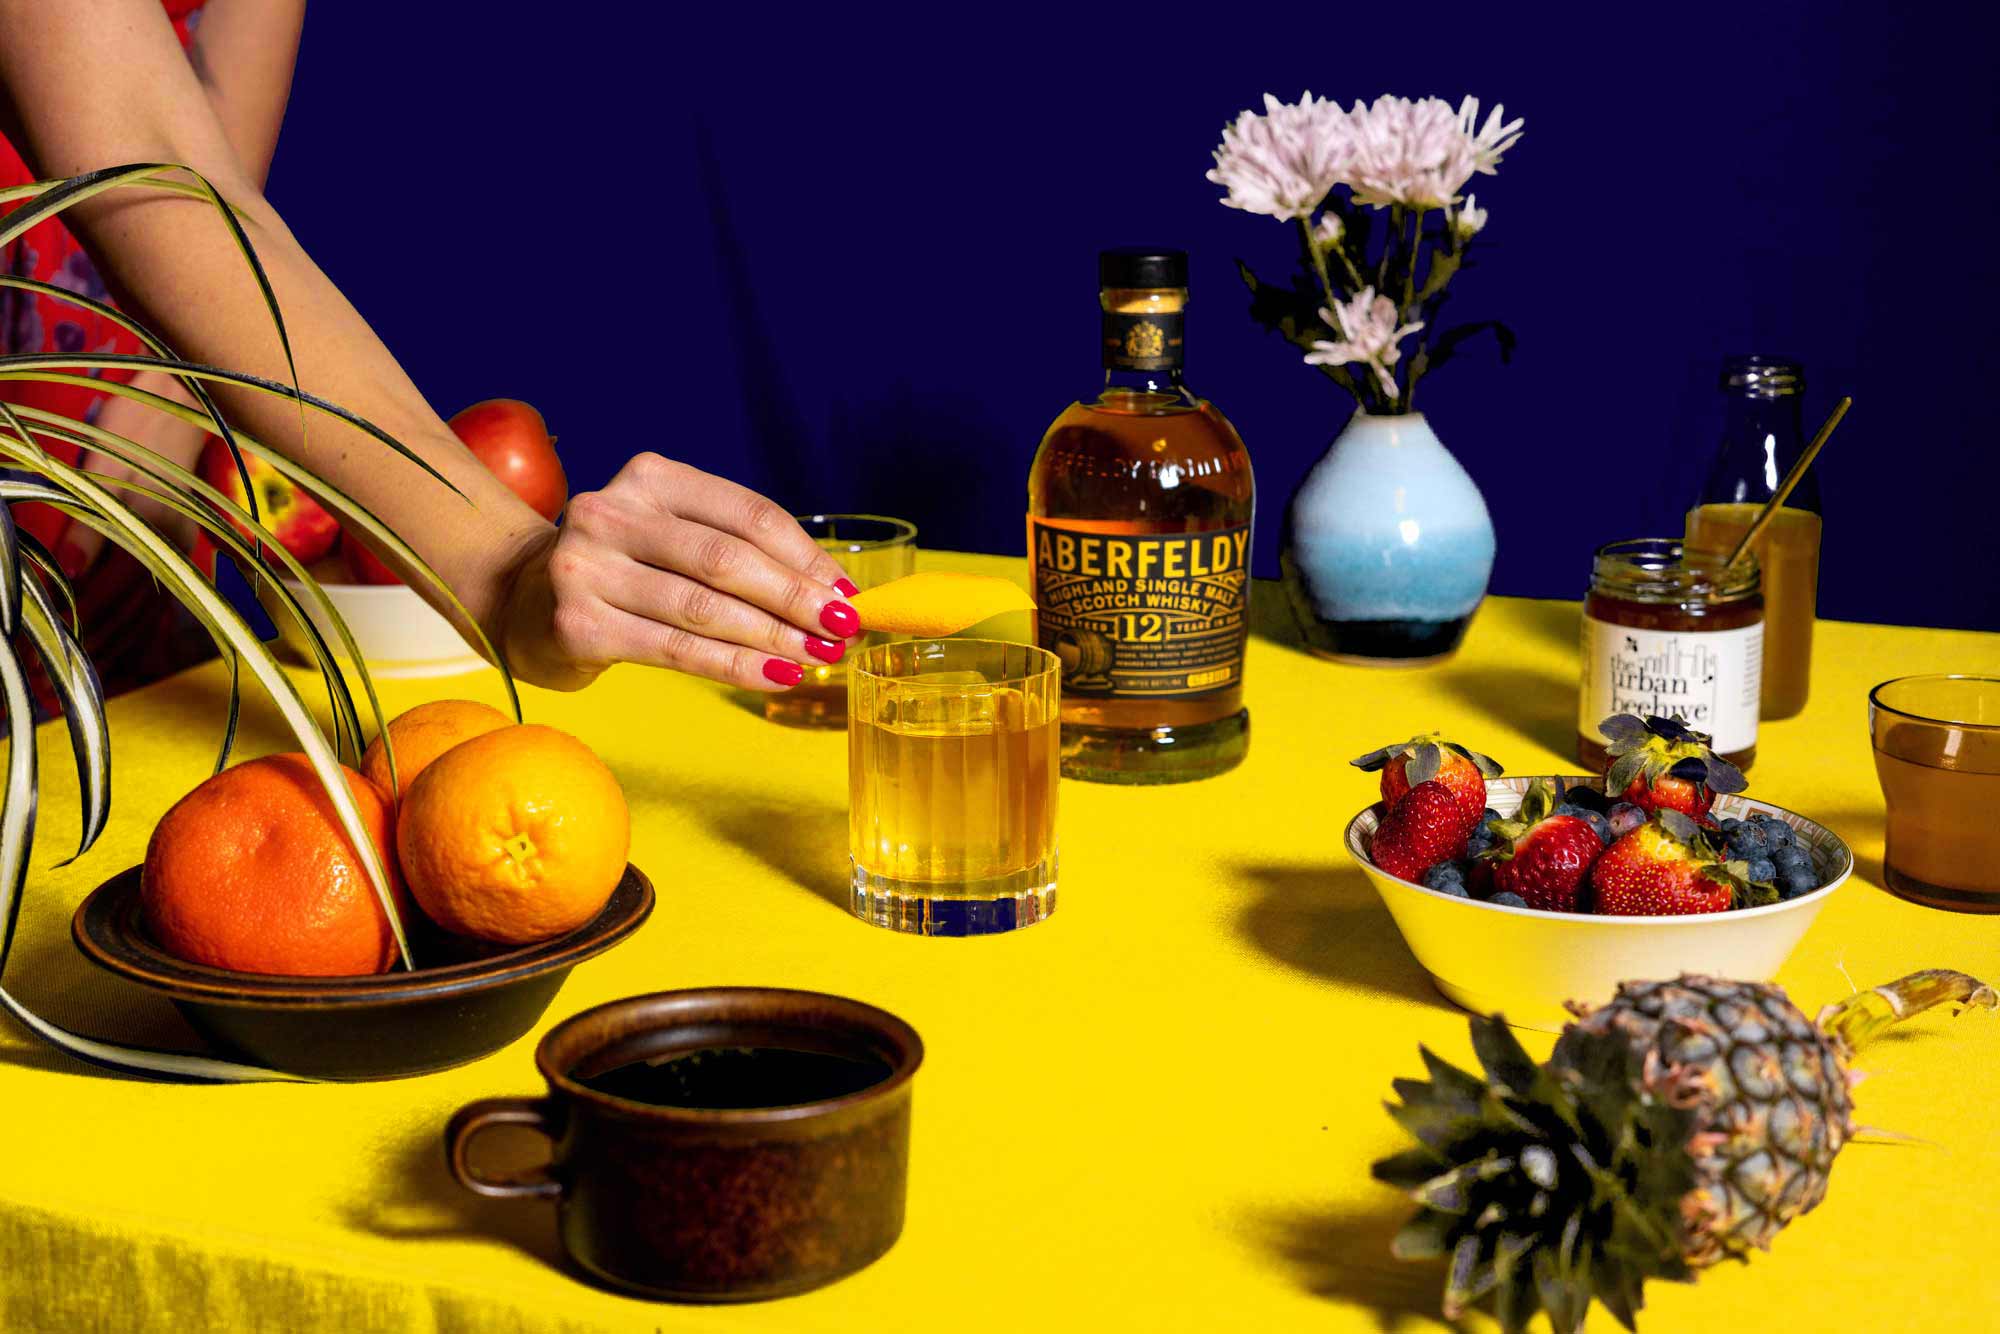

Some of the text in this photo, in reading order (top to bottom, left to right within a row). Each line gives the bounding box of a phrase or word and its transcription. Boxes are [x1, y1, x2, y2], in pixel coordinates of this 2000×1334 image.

[1040, 530, 1248, 578] ABERFELDY
[1049, 579, 1234, 604] HIGHLAND SINGLE MALT
[1072, 594, 1210, 613] SCOTCH WHISKY
[1123, 614, 1162, 642] 12
[1611, 653, 1634, 671] the
[1612, 666, 1687, 694] urban
[1611, 694, 1707, 720] beehive
